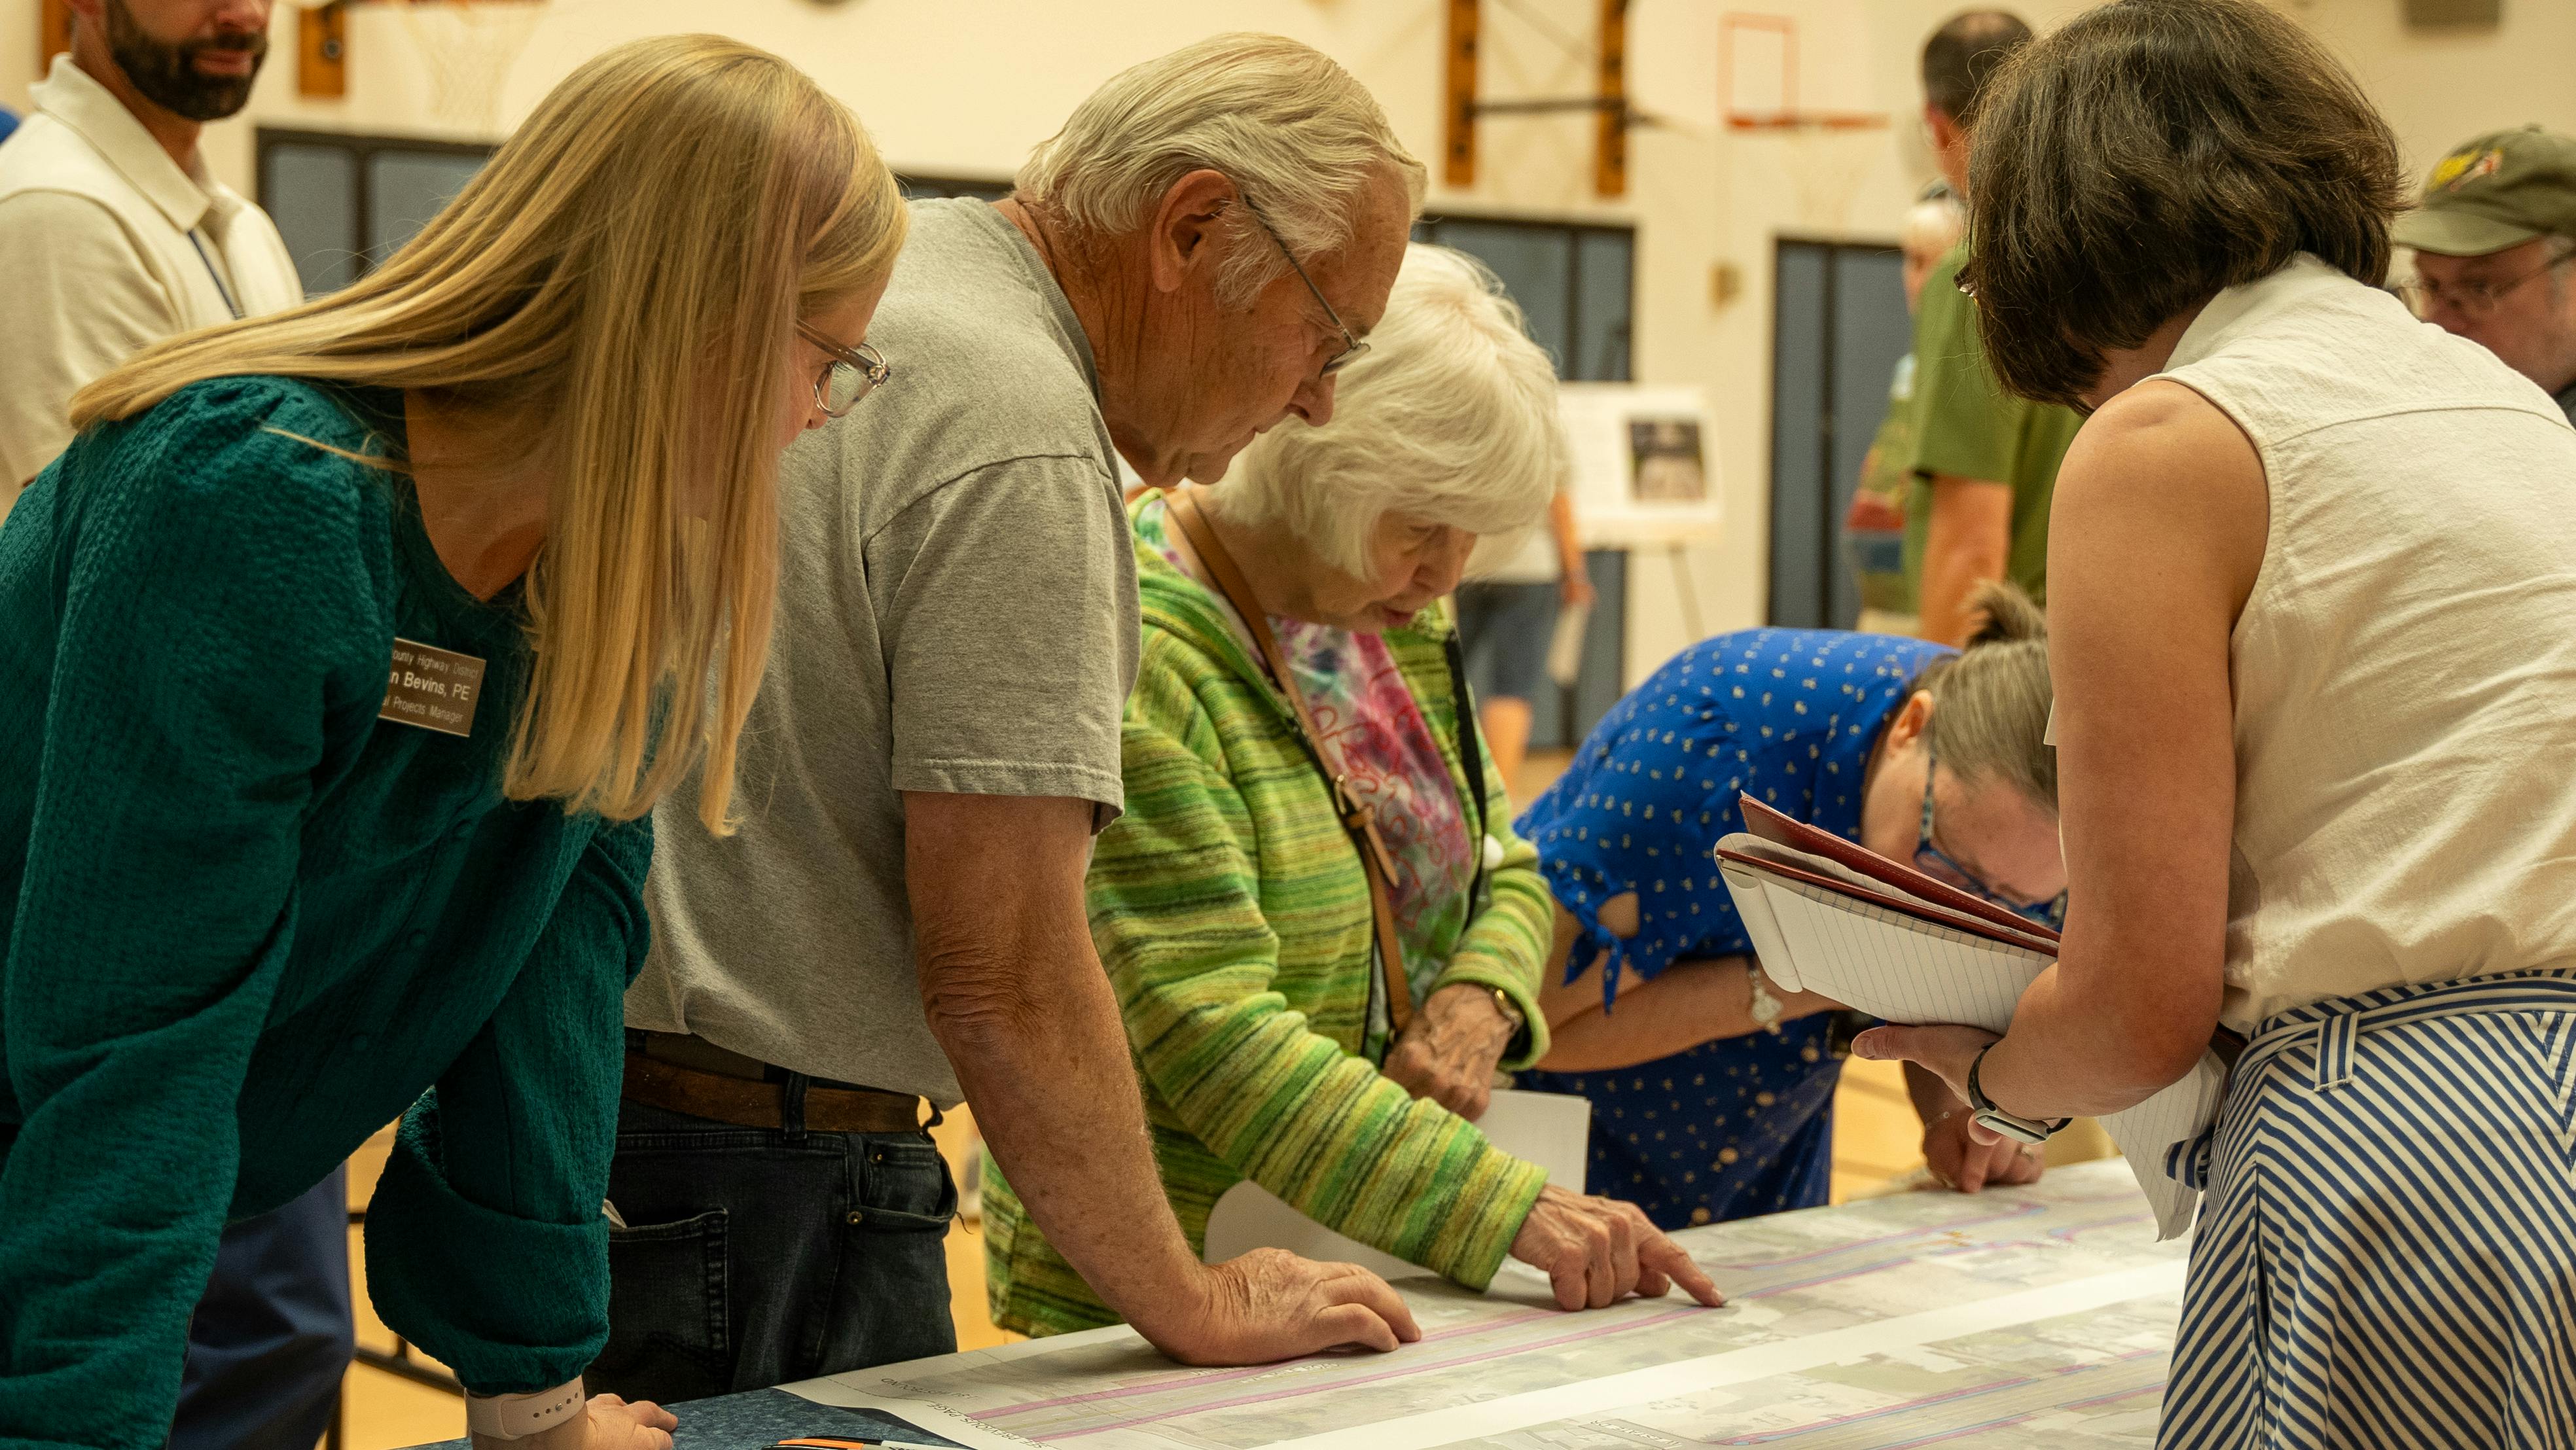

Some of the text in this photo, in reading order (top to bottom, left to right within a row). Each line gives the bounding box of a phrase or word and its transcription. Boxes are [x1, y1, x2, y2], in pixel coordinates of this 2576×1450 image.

[418, 654, 450, 673] Highway
[454, 663, 478, 679] District
[404, 671, 446, 697] Bevins,
[452, 683, 471, 700] PE
[393, 696, 425, 715] Projects
[429, 705, 463, 724] Manager
[927, 1404, 1046, 1449] SEE PREVIOUS PAGE
